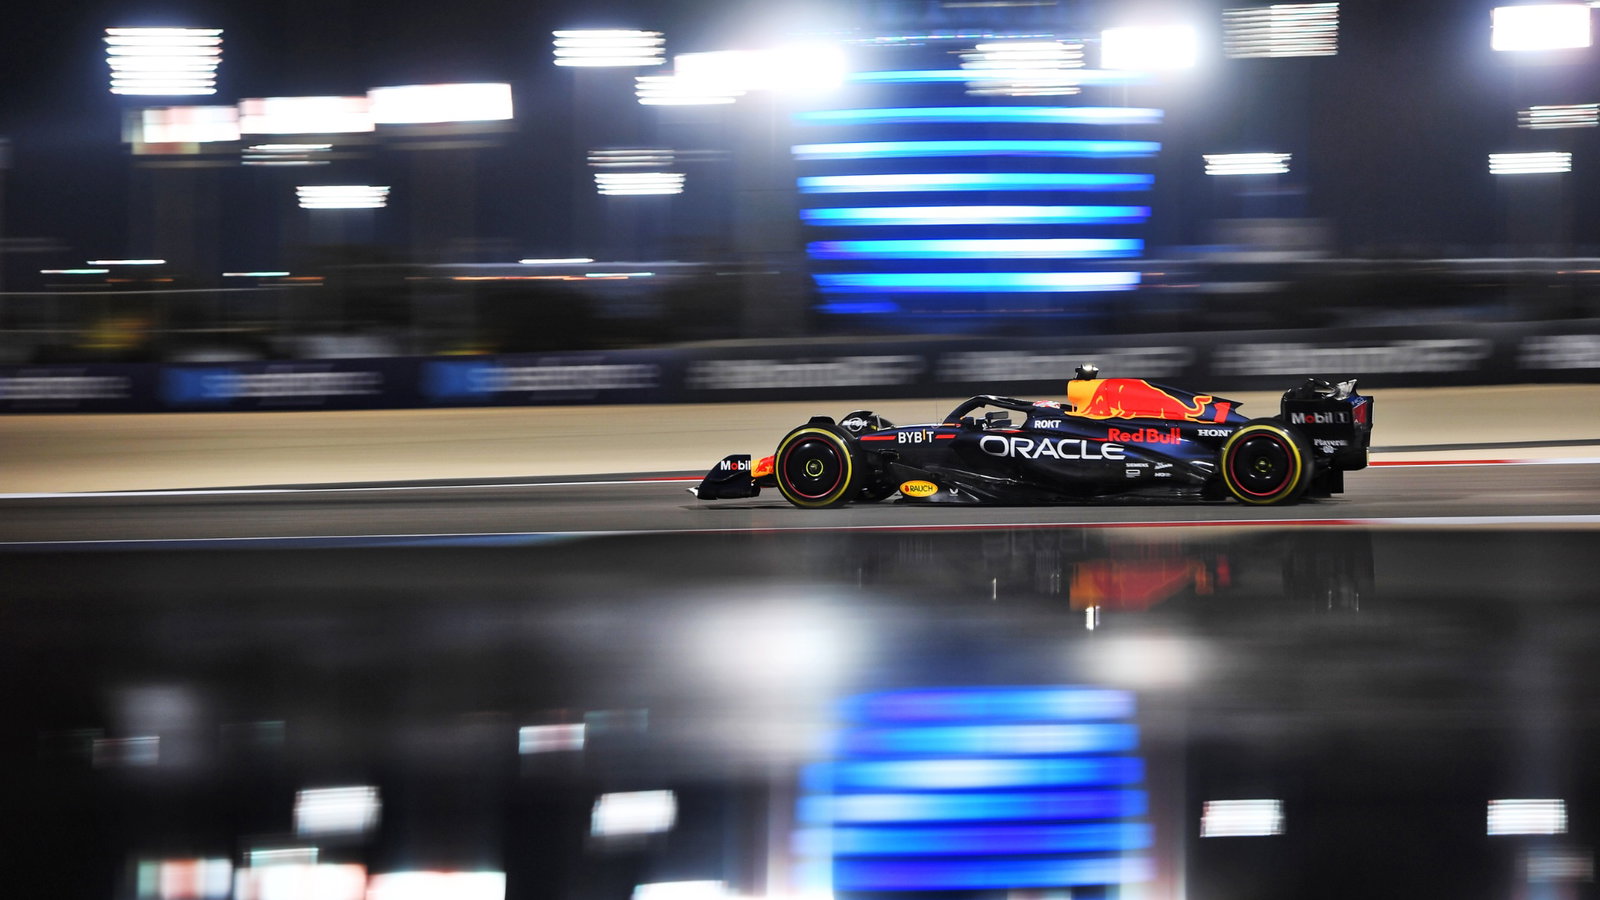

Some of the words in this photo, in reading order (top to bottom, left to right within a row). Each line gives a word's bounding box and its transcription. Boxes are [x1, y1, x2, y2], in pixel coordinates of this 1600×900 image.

[1213, 402, 1231, 424] 1
[1291, 412, 1333, 424] Mobil
[1034, 419, 1061, 429] ROKT
[898, 429, 934, 444] BYBIT
[1108, 428, 1144, 442] Red
[1146, 427, 1181, 445] Bull
[1197, 429, 1232, 437] HON
[980, 435, 1126, 460] ORACLE
[720, 460, 751, 471] Mobil
[909, 485, 933, 493] RAUCH
